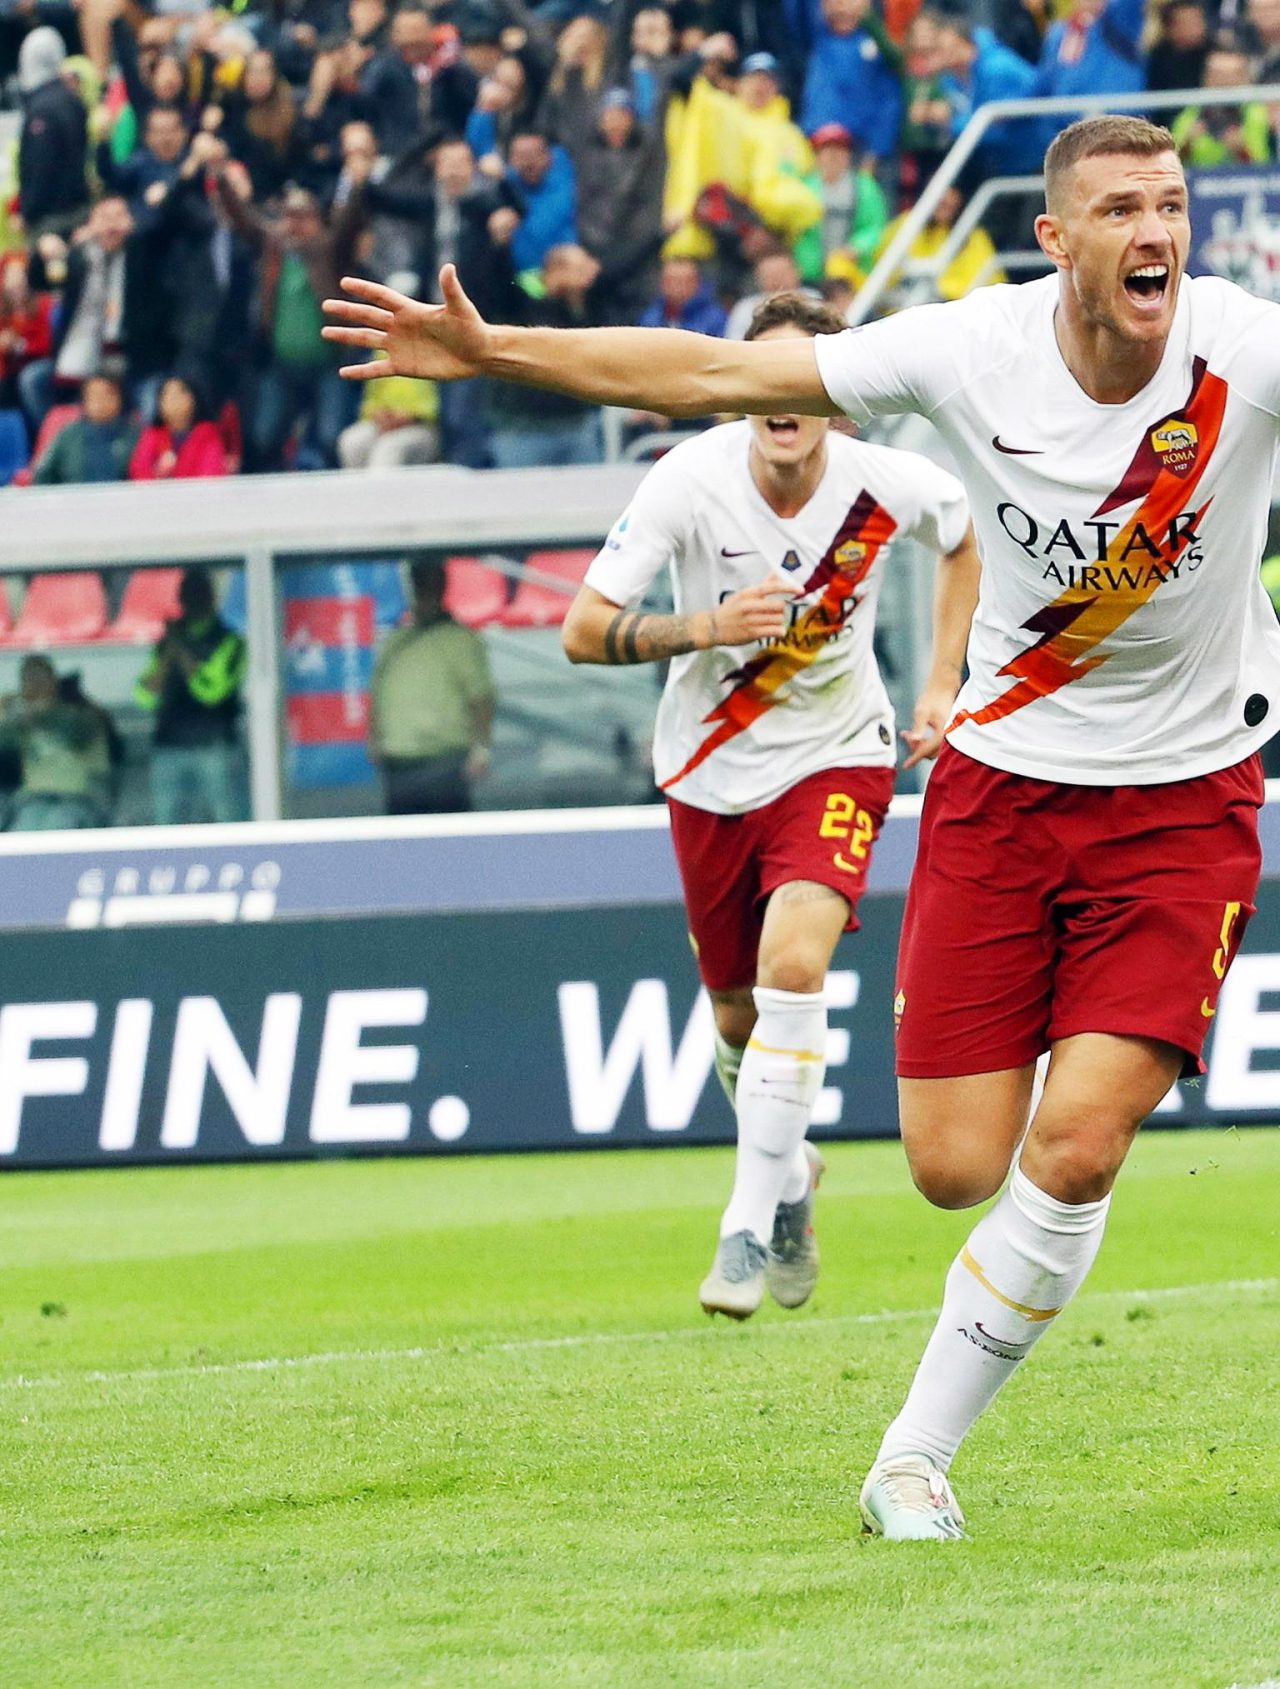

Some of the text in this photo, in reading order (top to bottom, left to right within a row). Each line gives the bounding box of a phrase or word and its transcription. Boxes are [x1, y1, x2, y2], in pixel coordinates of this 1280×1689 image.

[1162, 449, 1196, 465] ROMA
[996, 501, 1202, 563] QATAR
[1041, 546, 1205, 592] AIRWAYS
[819, 791, 874, 858] 22
[77, 860, 282, 898] GRUPPO
